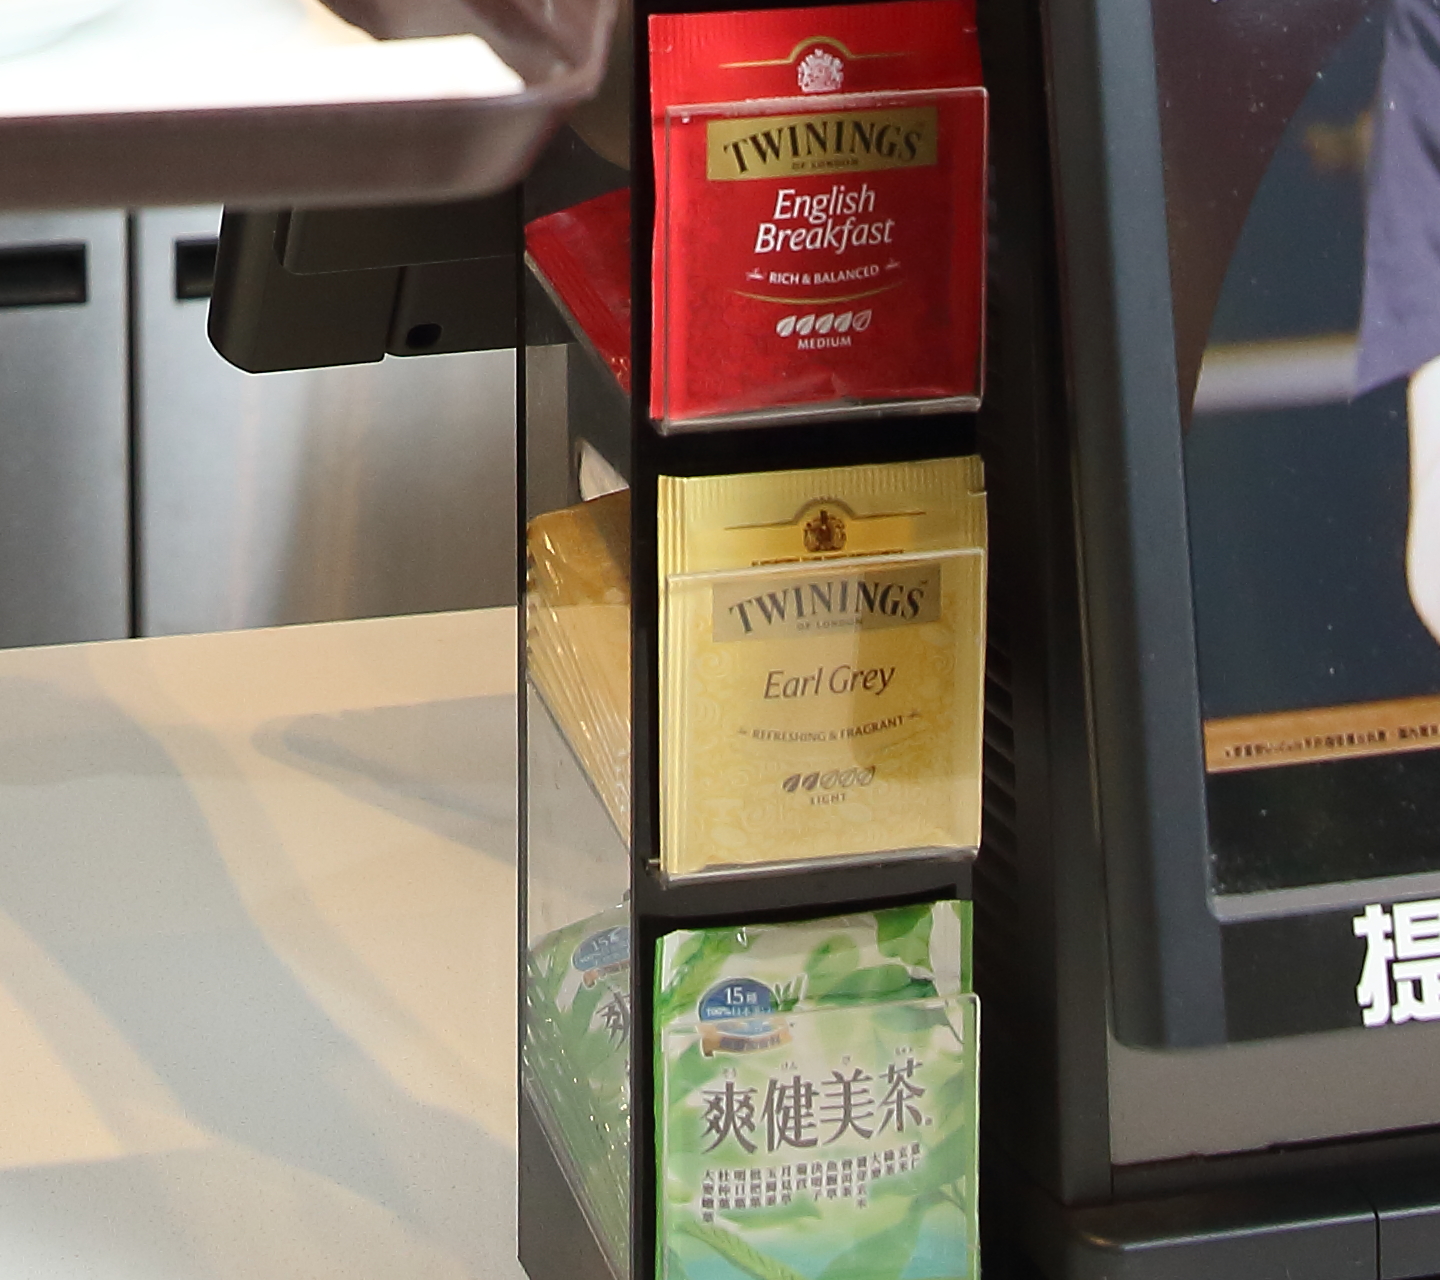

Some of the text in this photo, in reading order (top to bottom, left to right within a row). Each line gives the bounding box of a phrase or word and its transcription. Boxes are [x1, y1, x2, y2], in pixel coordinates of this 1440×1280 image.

[723, 119, 923, 175] TWININGS
[773, 183, 876, 225] English
[754, 216, 896, 255] Breakfast
[769, 270, 800, 286] RICH
[813, 264, 880, 285] BALANCED
[797, 335, 852, 351] MEDIUM
[728, 580, 925, 634] TWININGS
[763, 664, 897, 700] Earl Grey
[752, 727, 827, 742] REFRESHING
[839, 714, 905, 738] FRAGRANT
[810, 792, 848, 806] LIGHT
[700, 1057, 927, 1155] 爽健美茶
